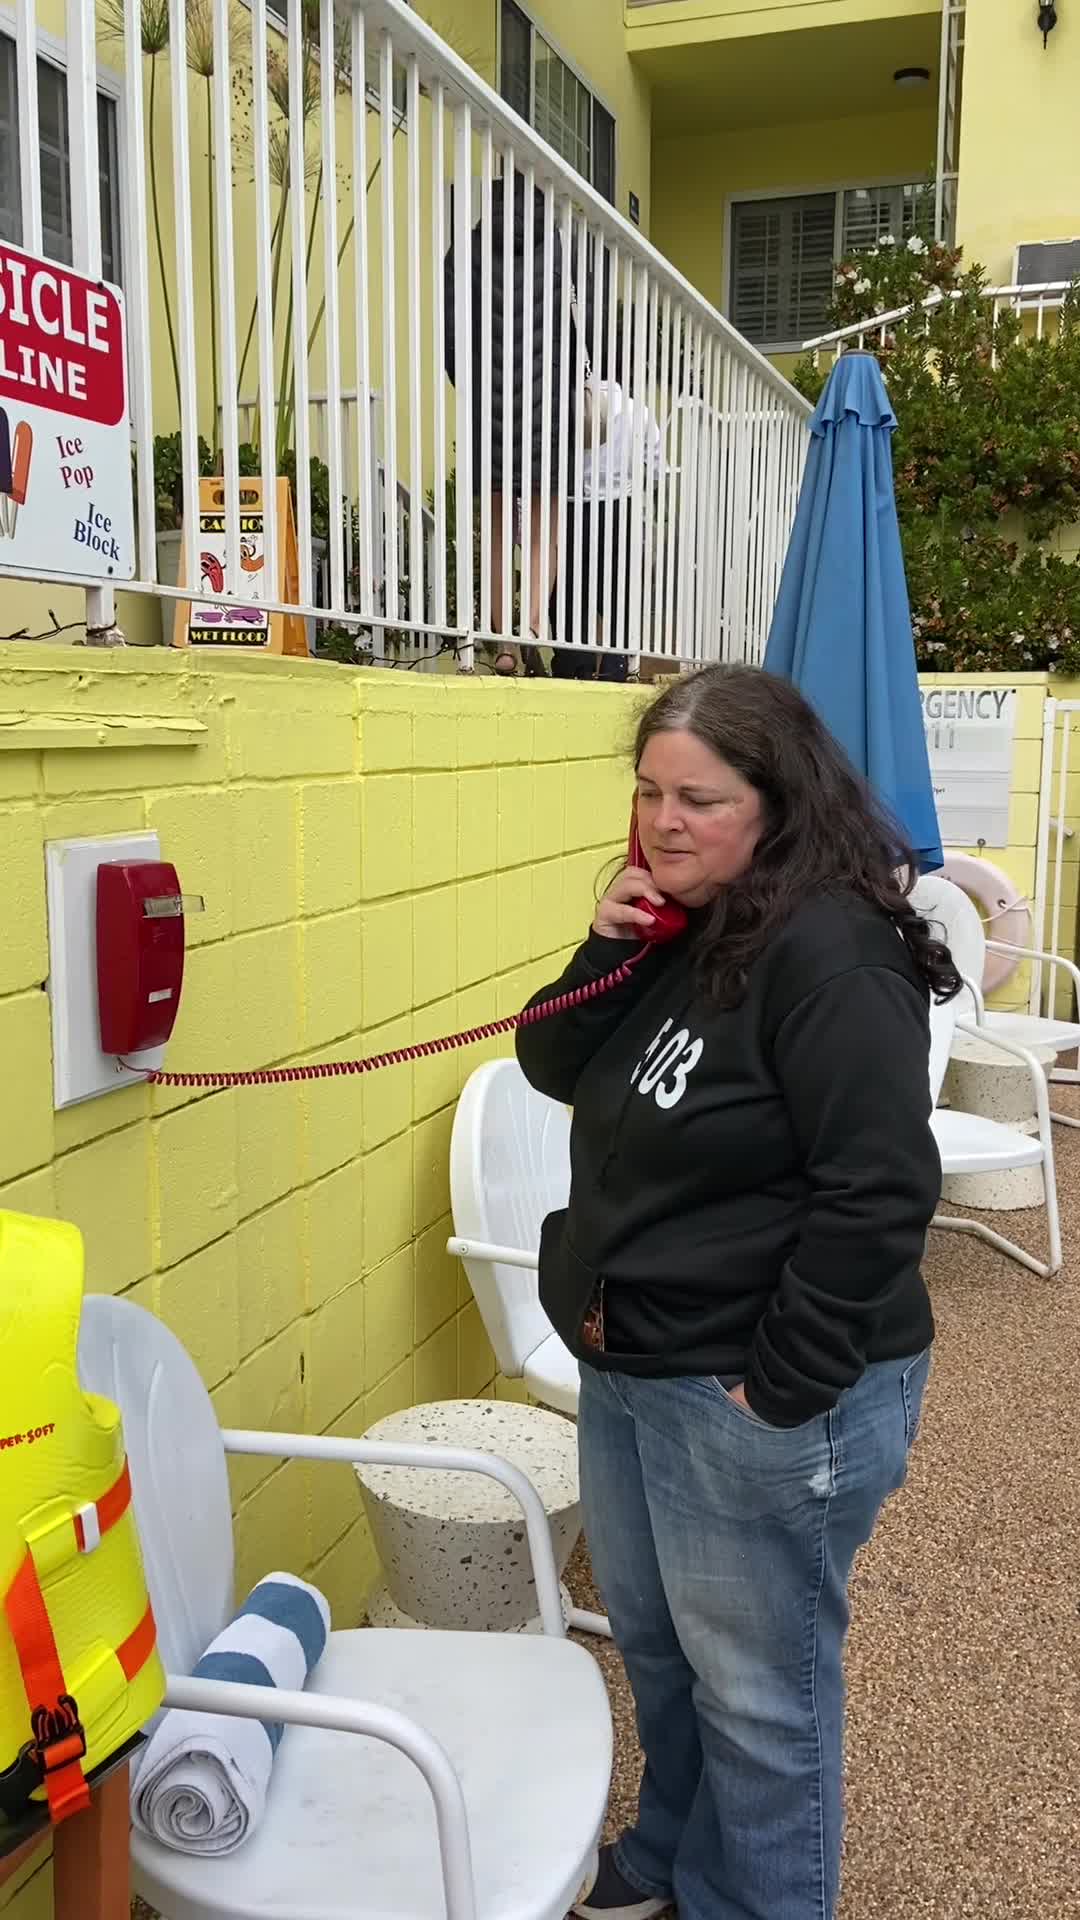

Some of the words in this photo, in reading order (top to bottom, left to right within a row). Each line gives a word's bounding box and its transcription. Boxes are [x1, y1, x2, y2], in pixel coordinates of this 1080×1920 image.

[0, 256, 110, 354] ICLE
[56, 435, 84, 459] Ice
[60, 465, 94, 489] Pop
[87, 502, 112, 533] Ice
[73, 519, 120, 561] Block
[191, 631, 219, 641] WET
[222, 631, 266, 642] FLOOR
